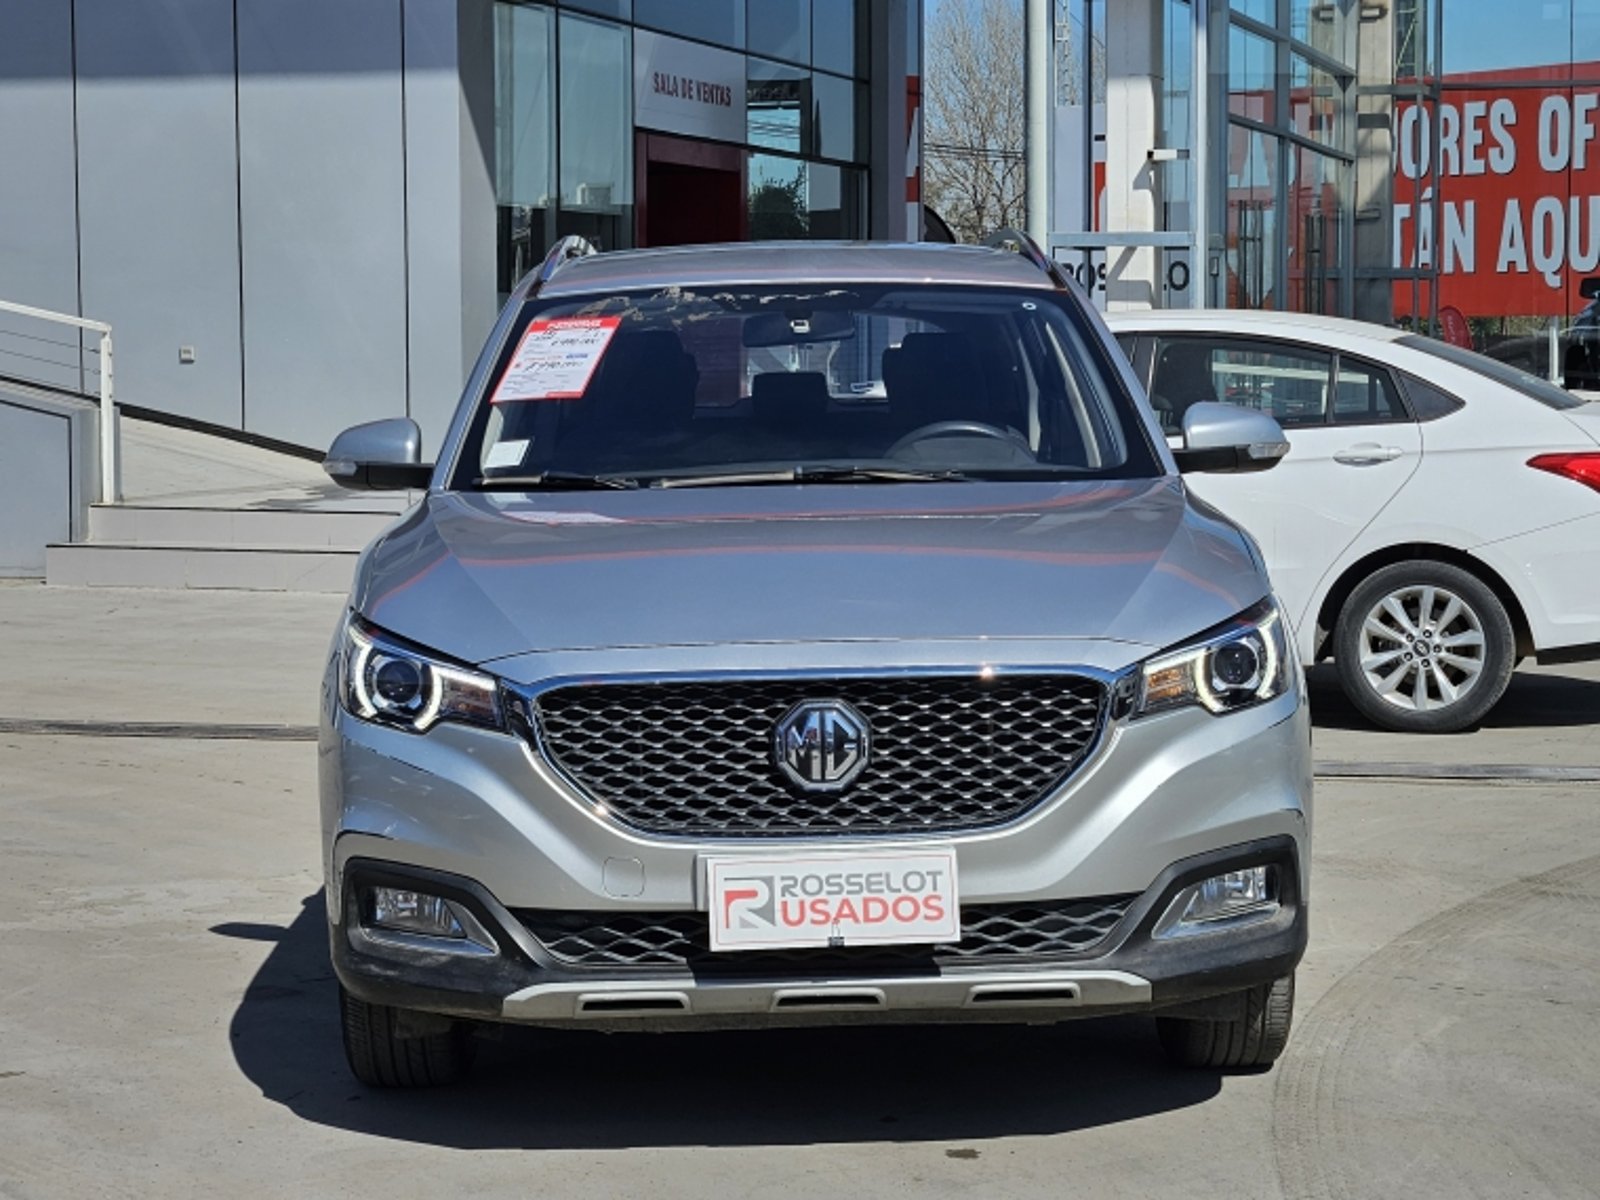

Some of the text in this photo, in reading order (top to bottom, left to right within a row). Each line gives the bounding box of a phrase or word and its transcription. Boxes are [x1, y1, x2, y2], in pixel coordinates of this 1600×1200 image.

[653, 71, 732, 108] SALA DE VENTAS
[1538, 94, 1599, 172] OF
[1496, 195, 1600, 288] AQU
[785, 708, 860, 782] MG
[780, 870, 943, 898] ROSSELOT
[780, 894, 945, 928] USADOS
